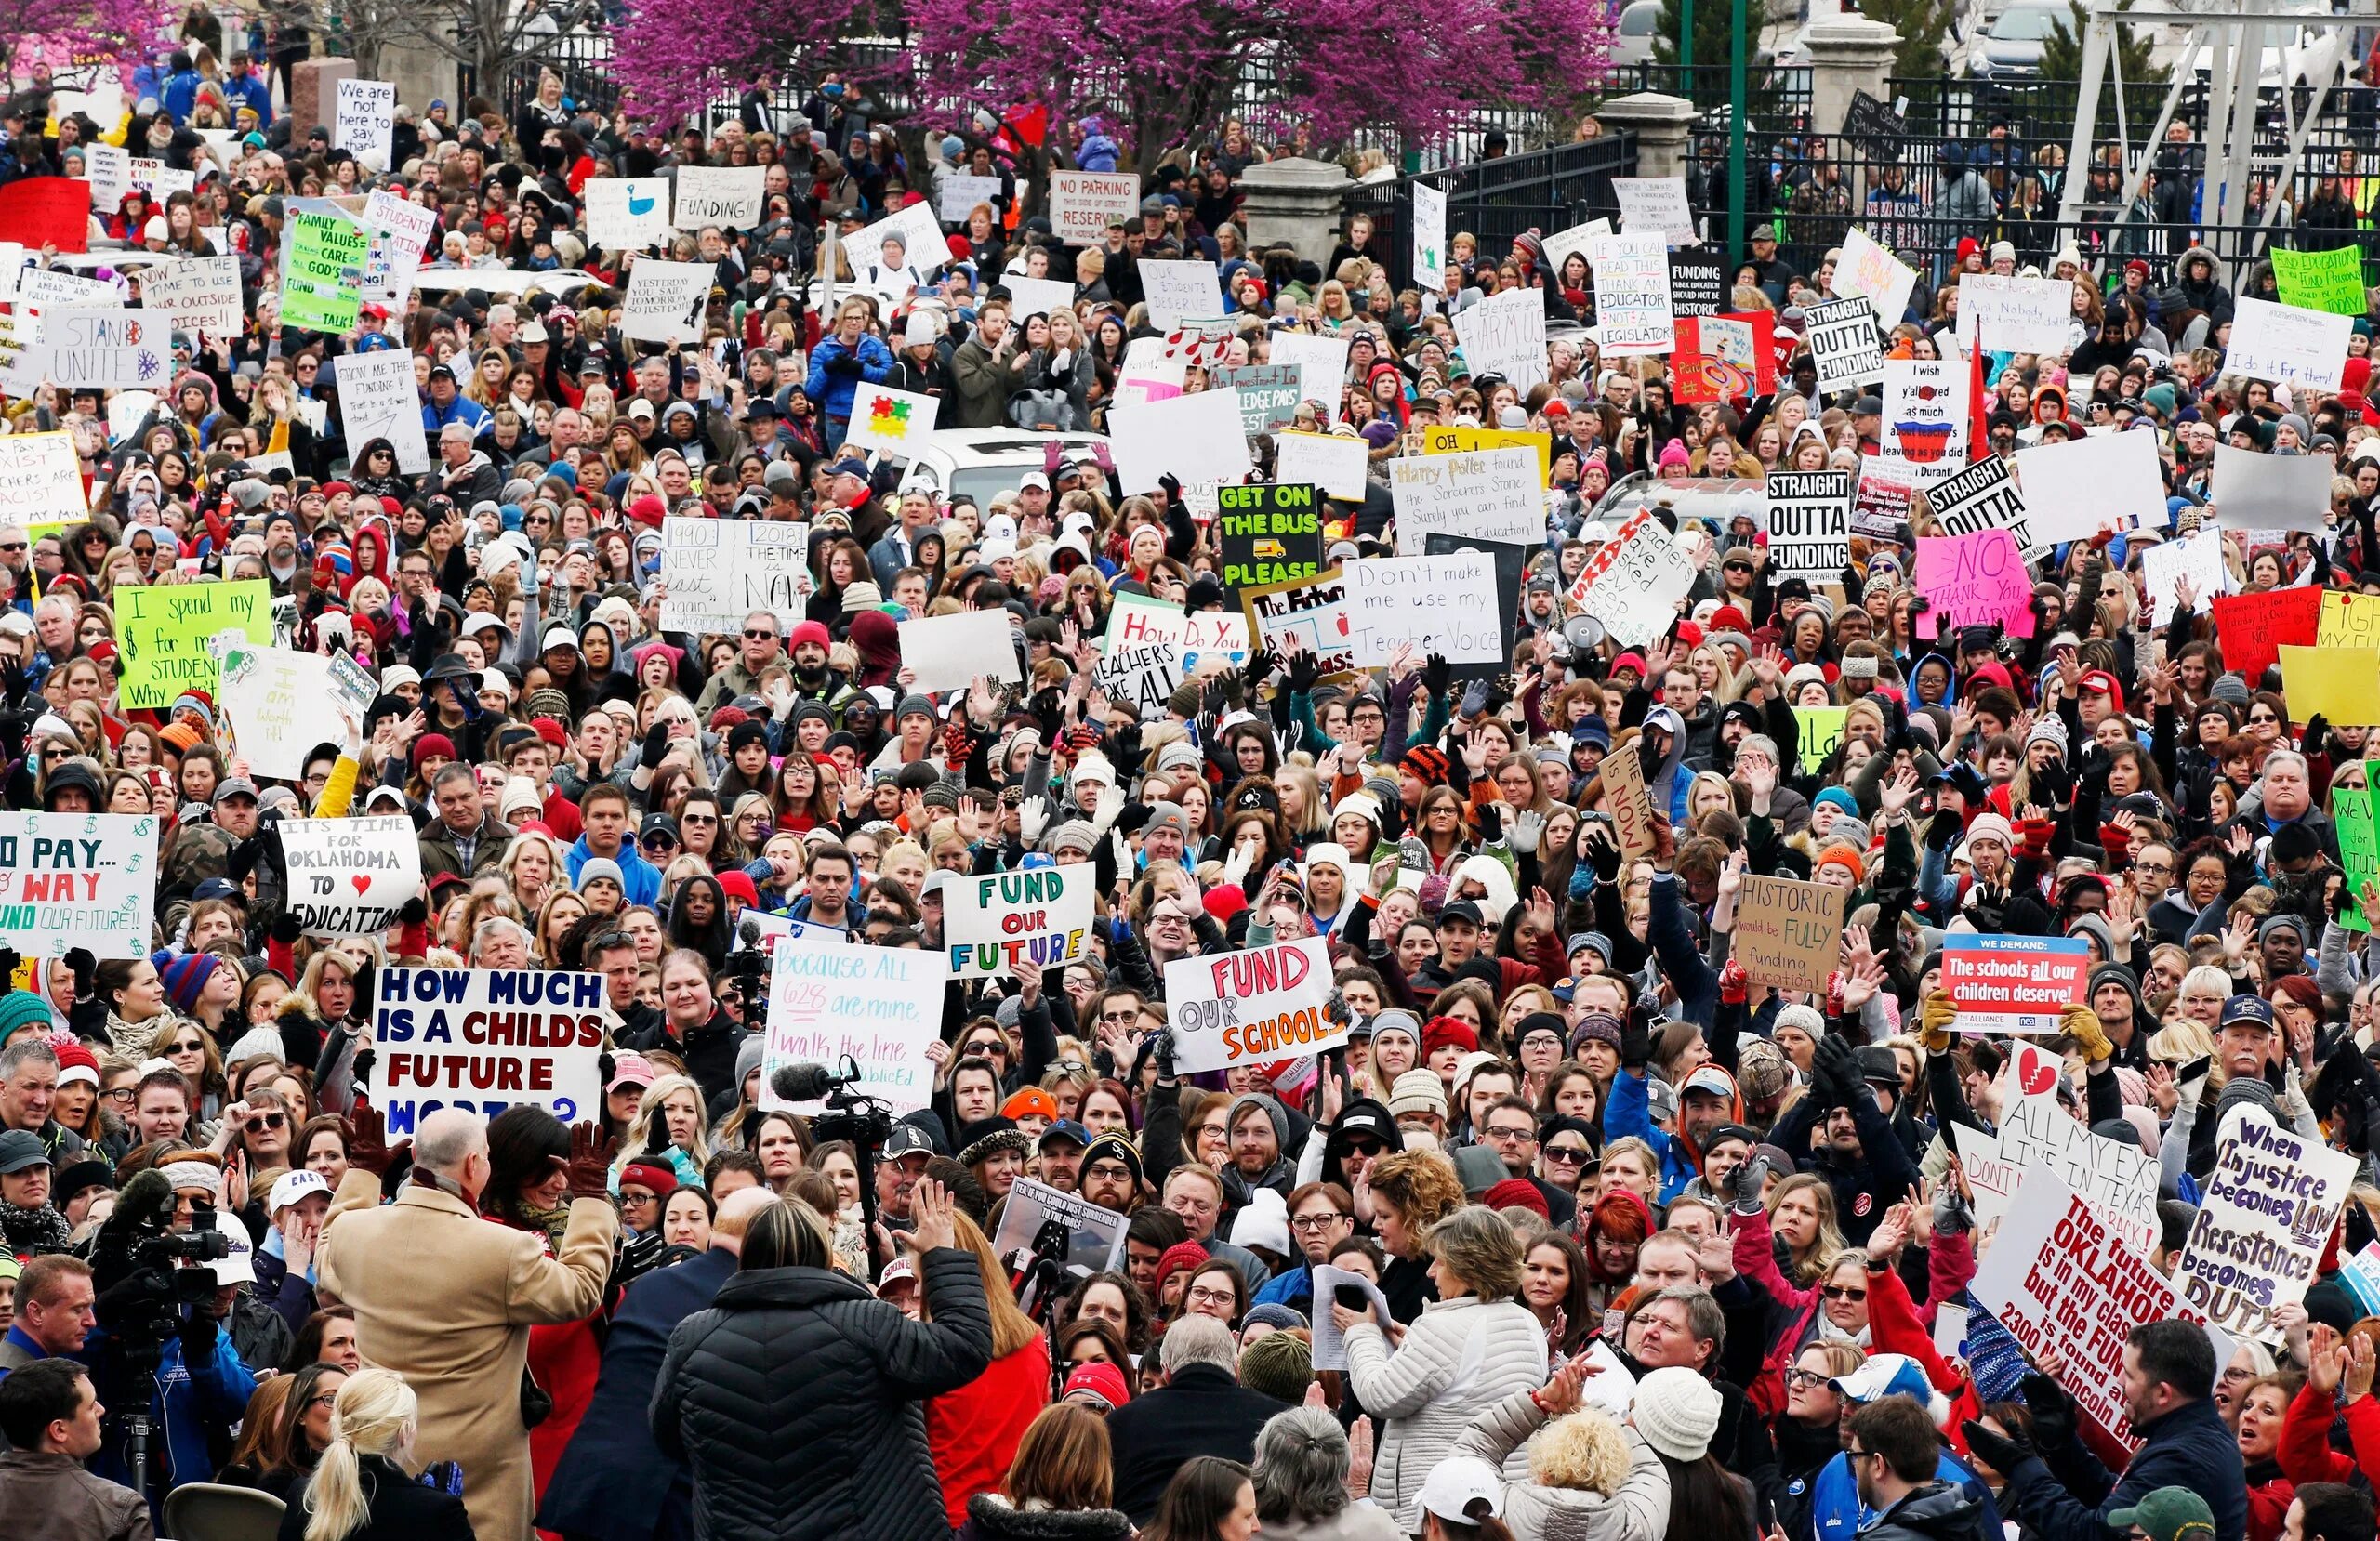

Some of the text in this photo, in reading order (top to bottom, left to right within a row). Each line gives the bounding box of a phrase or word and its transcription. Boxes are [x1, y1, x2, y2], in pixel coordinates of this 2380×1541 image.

[339, 84, 390, 99] We are
[353, 100, 376, 112] not
[339, 112, 390, 129] here to
[352, 128, 375, 141] say
[130, 170, 157, 178] KIDS
[131, 159, 158, 169] FUND
[1060, 180, 1130, 195] NO PARKING
[1104, 200, 1127, 208] STREET
[298, 213, 337, 230] FAMILY
[1596, 243, 1665, 256] IF YOU CAN
[139, 258, 231, 287] NOW IS THE
[638, 278, 689, 287] YESTERDAY
[1673, 266, 1720, 279] FUNDING
[148, 275, 233, 297] TIME TO USE
[286, 277, 314, 294] FUND
[659, 286, 682, 296] SAID
[1601, 278, 1660, 291] THANK AN
[1673, 292, 1696, 300] SHOULD
[632, 295, 687, 305] TOMORROW
[1153, 296, 1209, 312] DESERVE
[1601, 294, 1665, 308] EDUCATOR
[1608, 311, 1648, 324] NOT A
[1805, 299, 1871, 326] STRAIGHT
[65, 317, 143, 347] STAND
[1601, 326, 1673, 344] LEGISLATOR!
[1813, 323, 1875, 355] OUTTA
[54, 349, 160, 383] UNITED
[1817, 350, 1883, 380] FUNDING
[1913, 365, 1940, 375] I wish
[1272, 389, 1298, 407] PAYS
[1906, 406, 1943, 416] as much
[43, 437, 67, 451] IS
[1436, 435, 1458, 450] OH
[1890, 427, 1957, 438] about teachers
[1883, 445, 1963, 459] leaving as you did
[53, 470, 75, 481] ARE
[1397, 454, 1526, 486] Harry Potter found
[1921, 467, 1953, 477] Durant!
[1768, 474, 1847, 496] STRAIGHT
[1929, 457, 2006, 511] STRAIGHT
[1220, 486, 1311, 508] GET ON
[1769, 506, 1846, 536] OUTTA
[1946, 486, 2025, 537] OUTTA
[1221, 513, 1318, 536] THE BUS
[1475, 518, 1534, 539] Education!
[1769, 545, 1847, 569] FUNDING
[1954, 534, 2006, 582] NO
[1224, 562, 1317, 586] PLEASE
[1358, 561, 1482, 586] Don't make
[131, 587, 254, 625] I spend my
[1252, 595, 1288, 618] The
[1365, 593, 1487, 612] me use my
[1139, 665, 1175, 714] ALL
[1625, 746, 1651, 834] THE TIME
[1608, 759, 1642, 849] IS NOW
[2334, 796, 2358, 819] We
[283, 818, 404, 834] IT'S TIME
[327, 835, 362, 848] FOR
[2350, 829, 2368, 847] for
[288, 850, 401, 869] OKLAHOMA
[22, 873, 100, 902] WAY
[310, 876, 335, 895] TO
[979, 871, 1064, 908] FUND
[1742, 878, 1833, 916] HISTORIC
[40, 907, 139, 930] OUR FUTURE!!
[1002, 910, 1047, 934] OUR
[1739, 918, 1832, 951] would be FULLY
[1980, 940, 2048, 951] WE DEMAND:
[951, 929, 1084, 972] FUTURE
[1748, 947, 1806, 977] funding
[778, 945, 911, 981] Because ALL
[1211, 945, 1310, 999] FUND
[1950, 957, 2077, 980] The schools all our
[381, 969, 602, 1008] HOW MUCH
[1954, 981, 2072, 1004] children deserve!
[784, 981, 920, 1023] 628 are mine.
[1179, 996, 1240, 1032] OUR
[377, 1008, 602, 1047] IS A CHILD'S
[1222, 1002, 1346, 1060] SCHOOLS
[388, 1053, 553, 1091] FUTURE
[2241, 1117, 2302, 1161] When
[291, 1174, 321, 1186] EAST
[1968, 1152, 2013, 1193] DON'T
[2219, 1139, 2327, 1200] Injustice
[1041, 1207, 1082, 1231] TO THE FORCE
[2191, 1209, 2313, 1281] Resistance
[2037, 1237, 2099, 1313] is in my
[2181, 1248, 2276, 1306] becomes
[2023, 1263, 2088, 1340] but the
[2040, 1315, 2127, 1408] is found at
